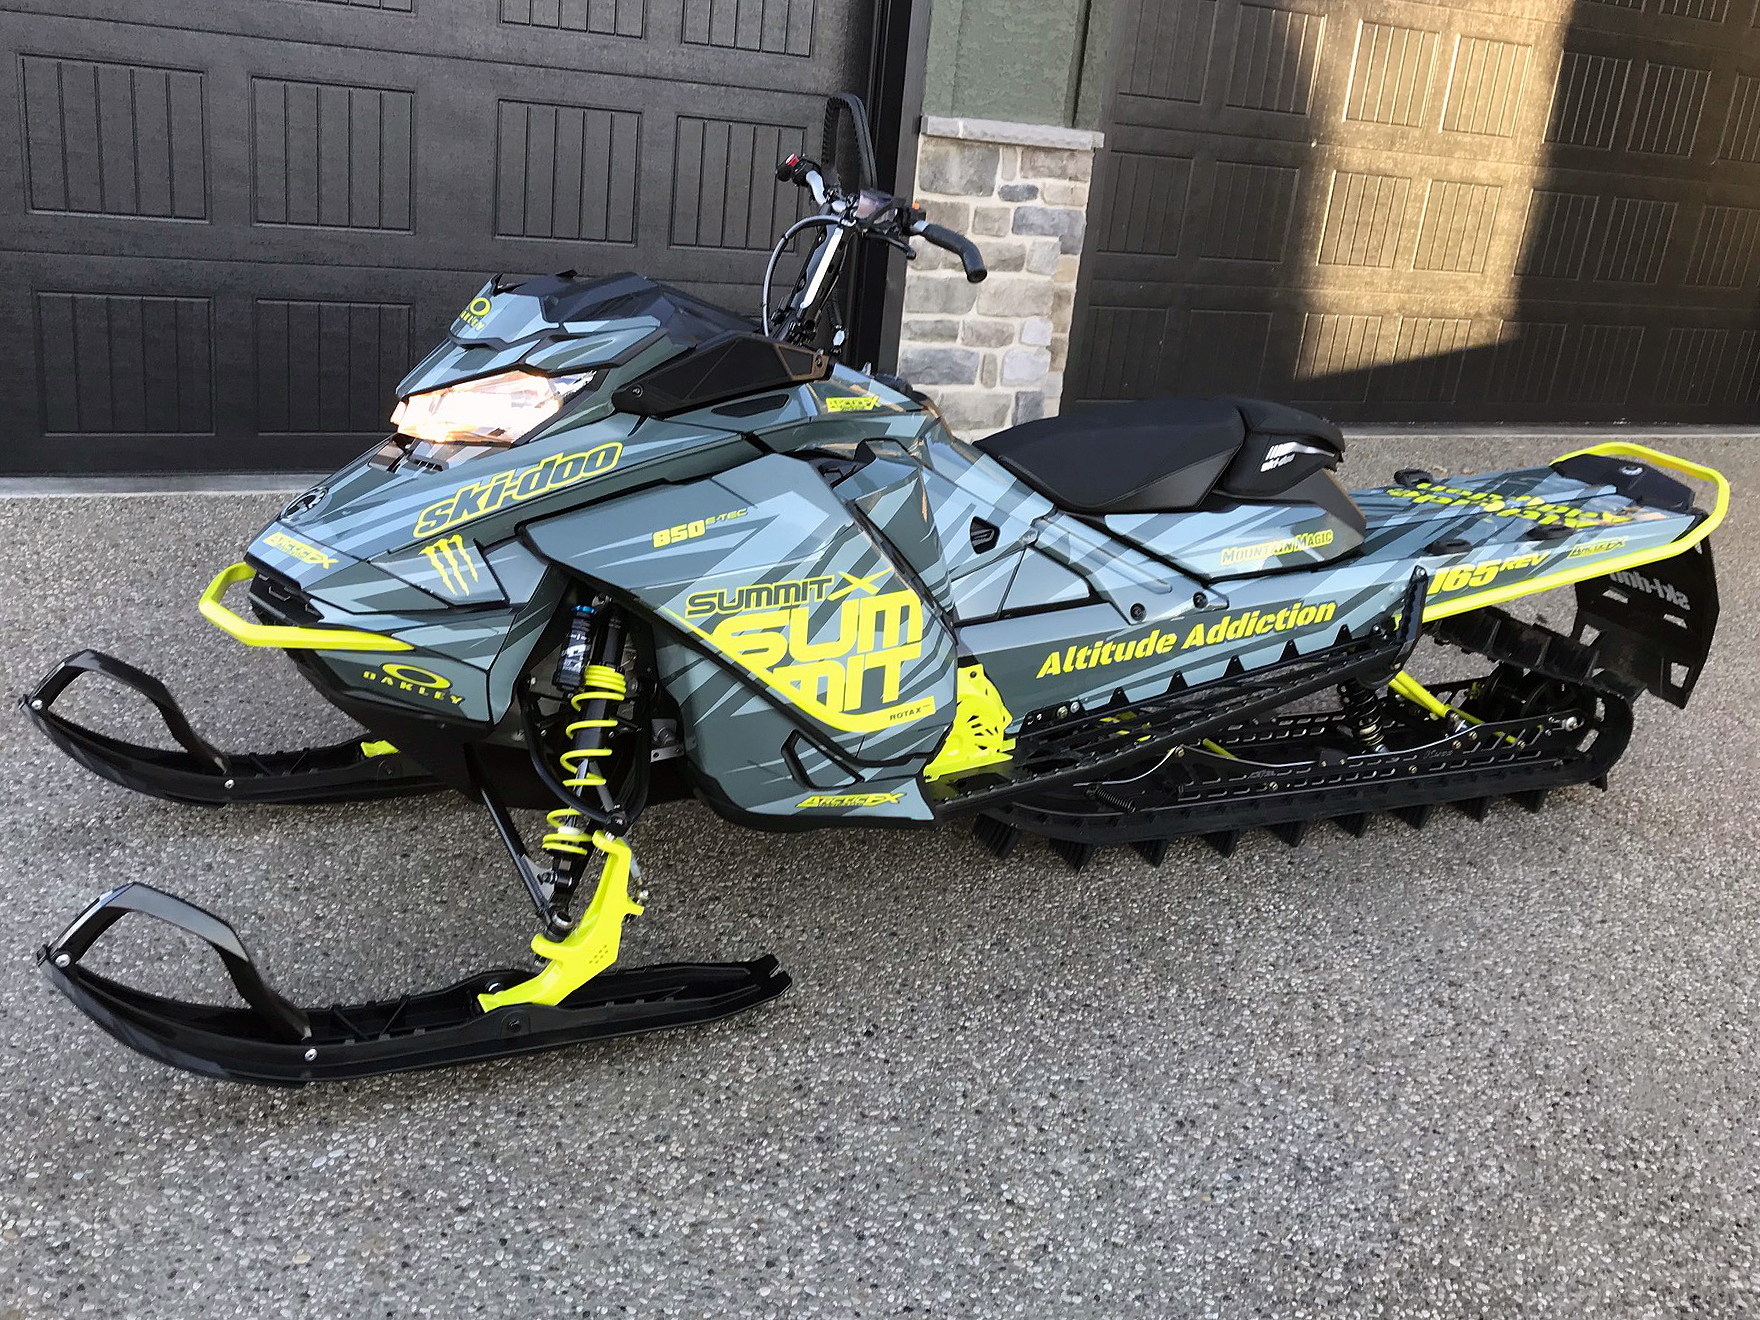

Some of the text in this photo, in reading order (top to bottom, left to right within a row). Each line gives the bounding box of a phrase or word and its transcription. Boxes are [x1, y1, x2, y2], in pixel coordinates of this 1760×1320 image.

[413, 442, 623, 538] ski-doo
[653, 519, 706, 548] 850
[1293, 529, 1334, 551] MAGIC
[1427, 551, 1551, 595] 165 REV
[684, 574, 835, 619] SUMMIT
[1036, 600, 1337, 679] Altitude Addiction
[363, 671, 463, 704] OAKLEY
[889, 706, 922, 721] ROTAX
